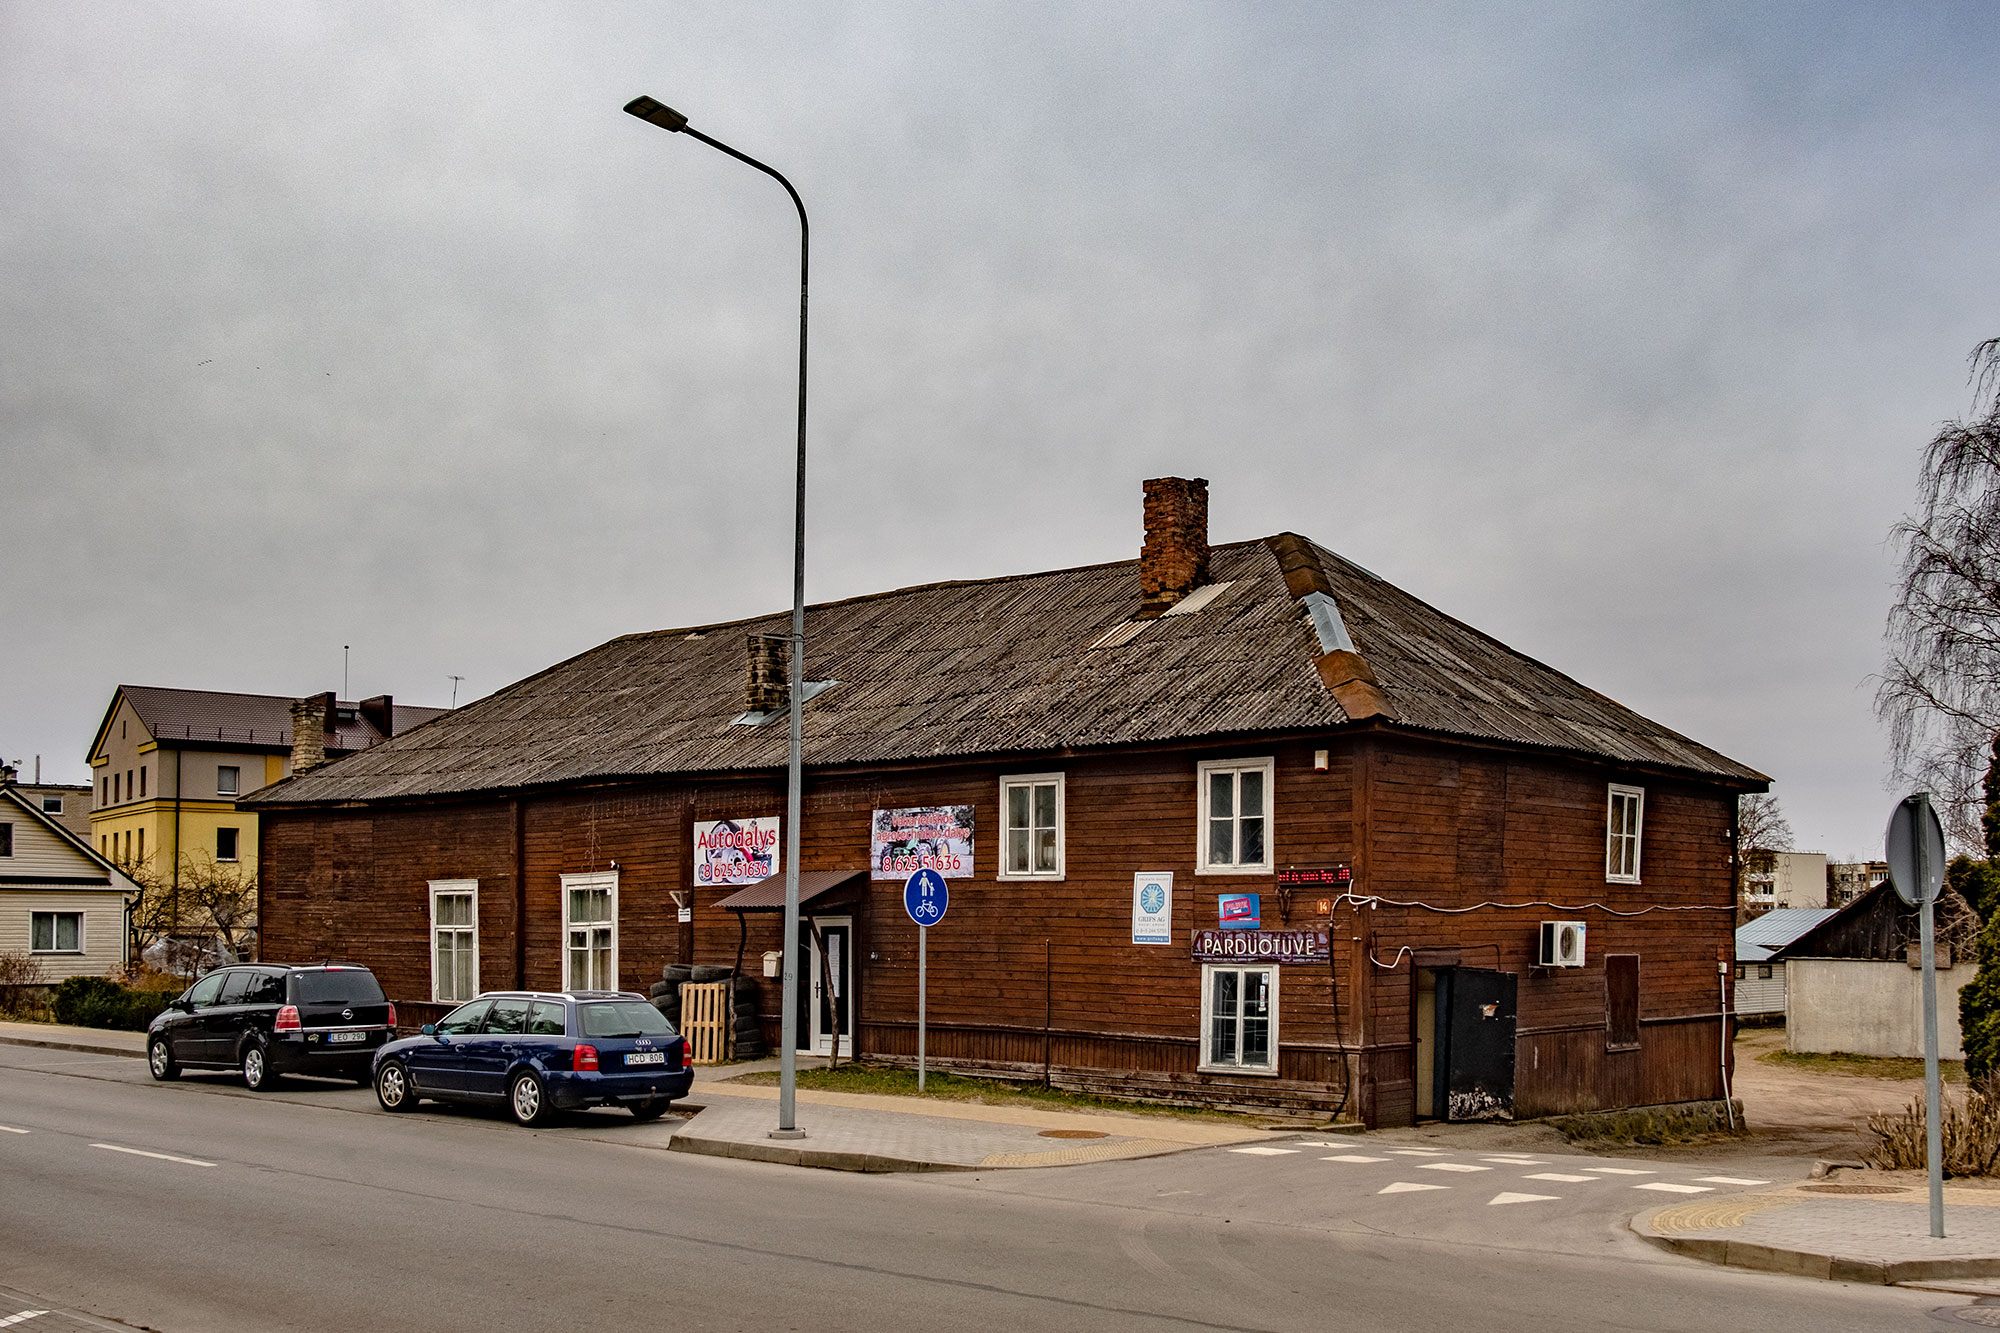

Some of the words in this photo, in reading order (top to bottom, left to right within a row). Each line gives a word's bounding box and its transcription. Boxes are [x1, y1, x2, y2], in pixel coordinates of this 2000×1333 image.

[698, 826, 776, 851] Autodalys
[877, 828, 942, 843] agrotechnikos
[944, 826, 970, 840] dalys
[704, 864, 711, 878] 8
[714, 863, 733, 877] 625
[737, 861, 768, 877] 51636
[883, 856, 891, 872] 8
[895, 855, 918, 872] 625
[922, 855, 961, 870] 51636
[1320, 902, 1327, 911] 14
[1204, 933, 1315, 956] PARDUOTUVĖ
[332, 1033, 348, 1041] LEO
[352, 1032, 365, 1040] 290
